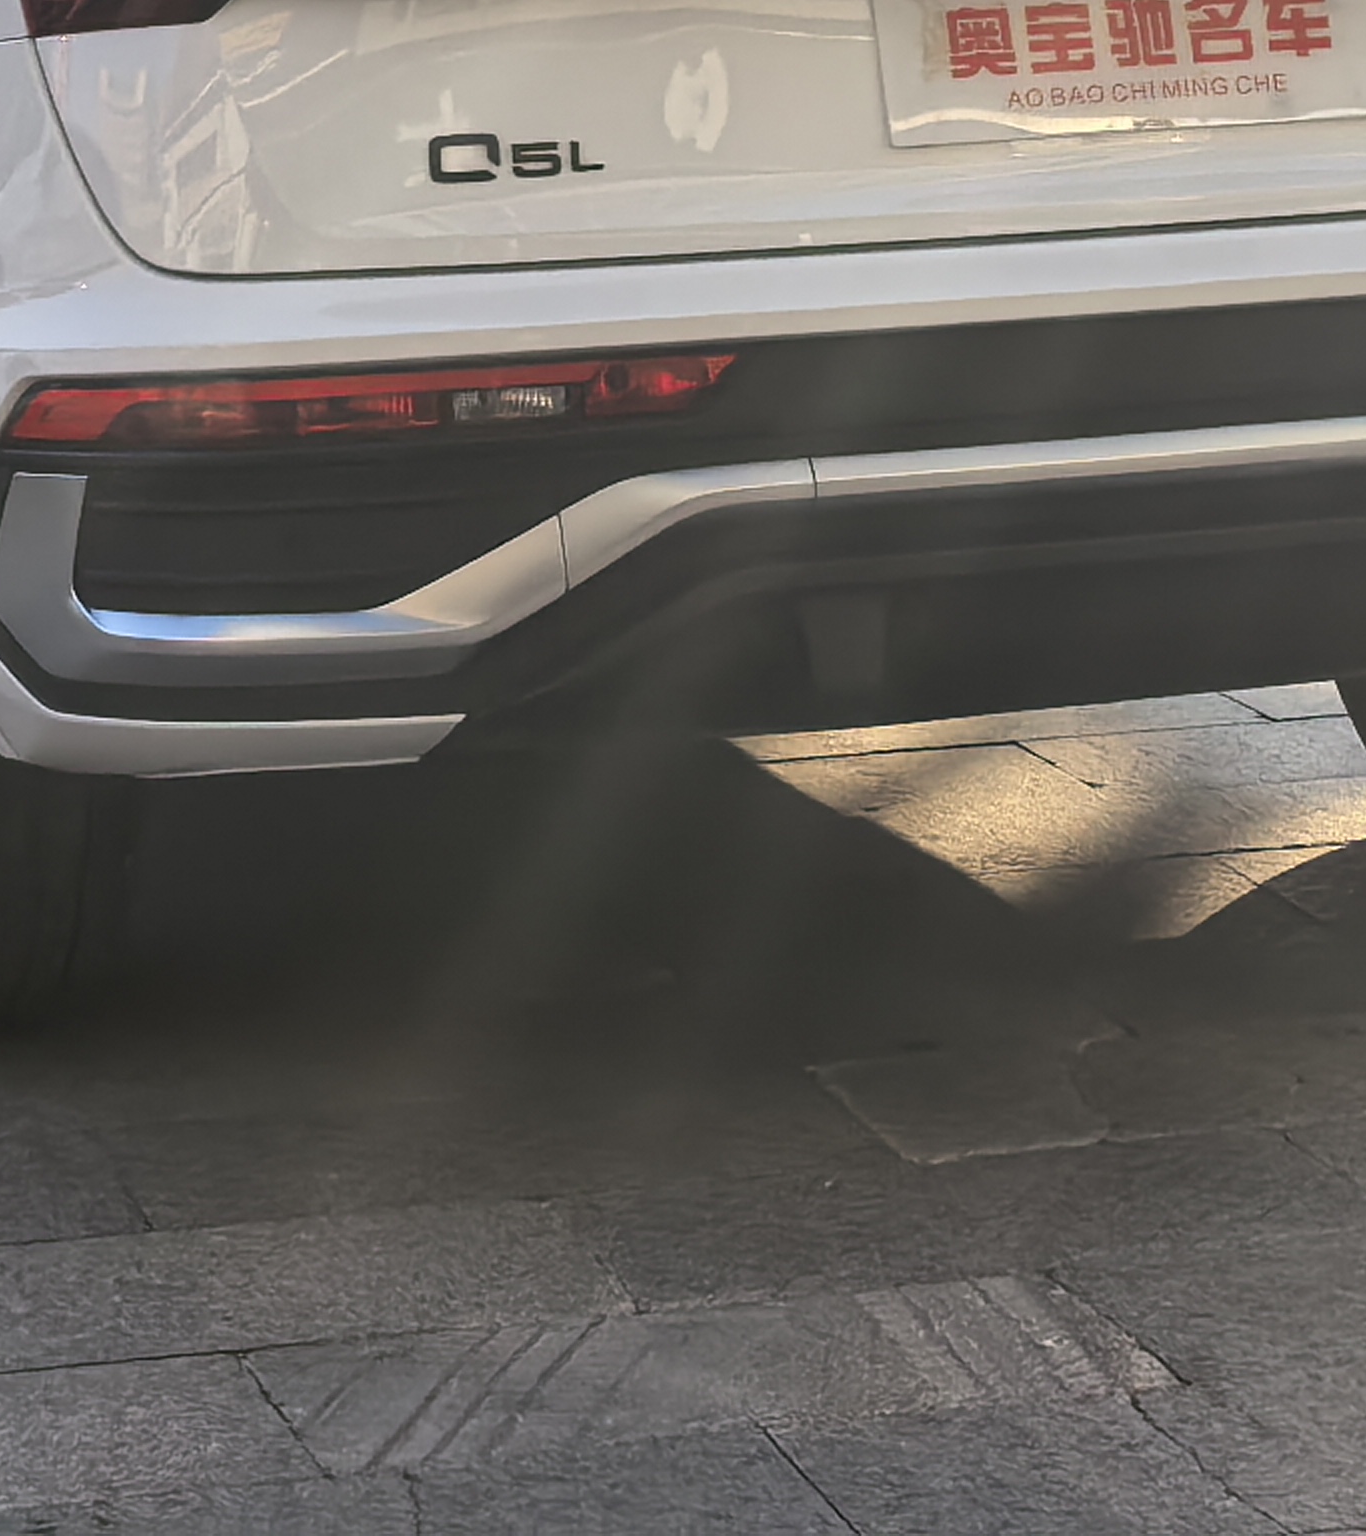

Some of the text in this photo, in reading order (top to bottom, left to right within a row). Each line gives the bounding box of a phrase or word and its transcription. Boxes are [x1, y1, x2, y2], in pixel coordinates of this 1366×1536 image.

[1008, 73, 1288, 108] AO BAO CHI MING CHE
[429, 133, 605, 183] Q5L
